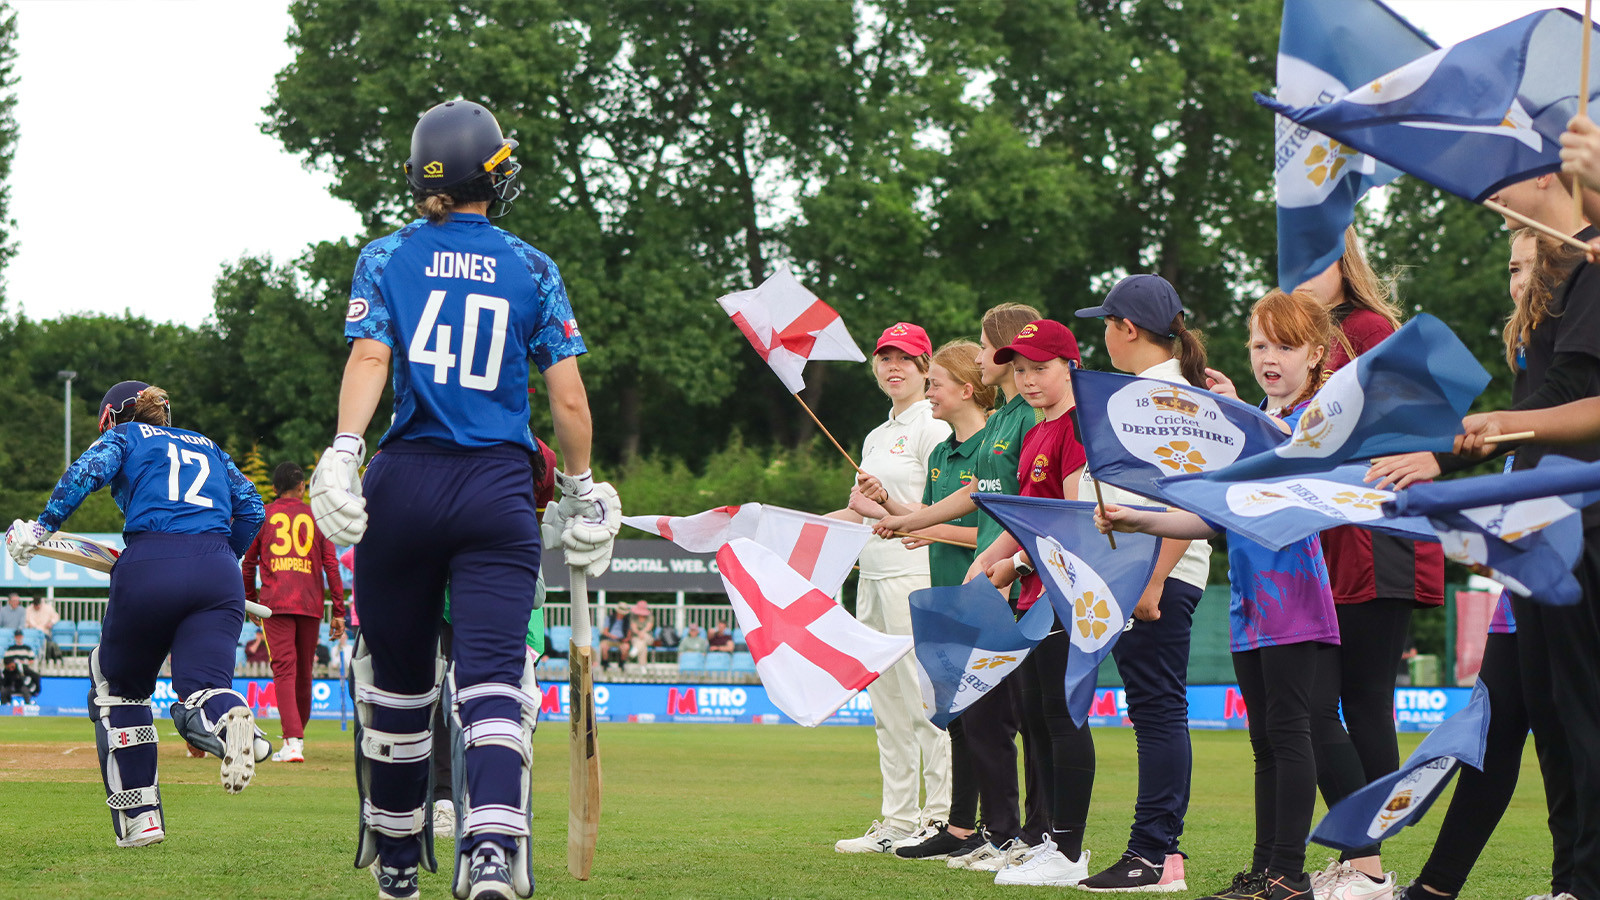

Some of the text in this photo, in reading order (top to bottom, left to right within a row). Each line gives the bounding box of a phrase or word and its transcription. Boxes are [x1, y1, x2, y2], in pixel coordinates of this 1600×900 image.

[425, 251, 497, 284] JONES
[408, 289, 510, 392] 40
[1135, 398, 1217, 421] 18 70
[1154, 415, 1201, 428] Cricket
[1121, 422, 1234, 447] DERBYSHIRE
[166, 441, 214, 508] 12
[269, 512, 315, 557] 30
[611, 558, 669, 573] DIGITAL.
[669, 558, 707, 573] WEB.
[667, 687, 747, 715] METRO
[1394, 689, 1448, 710] ETRO
